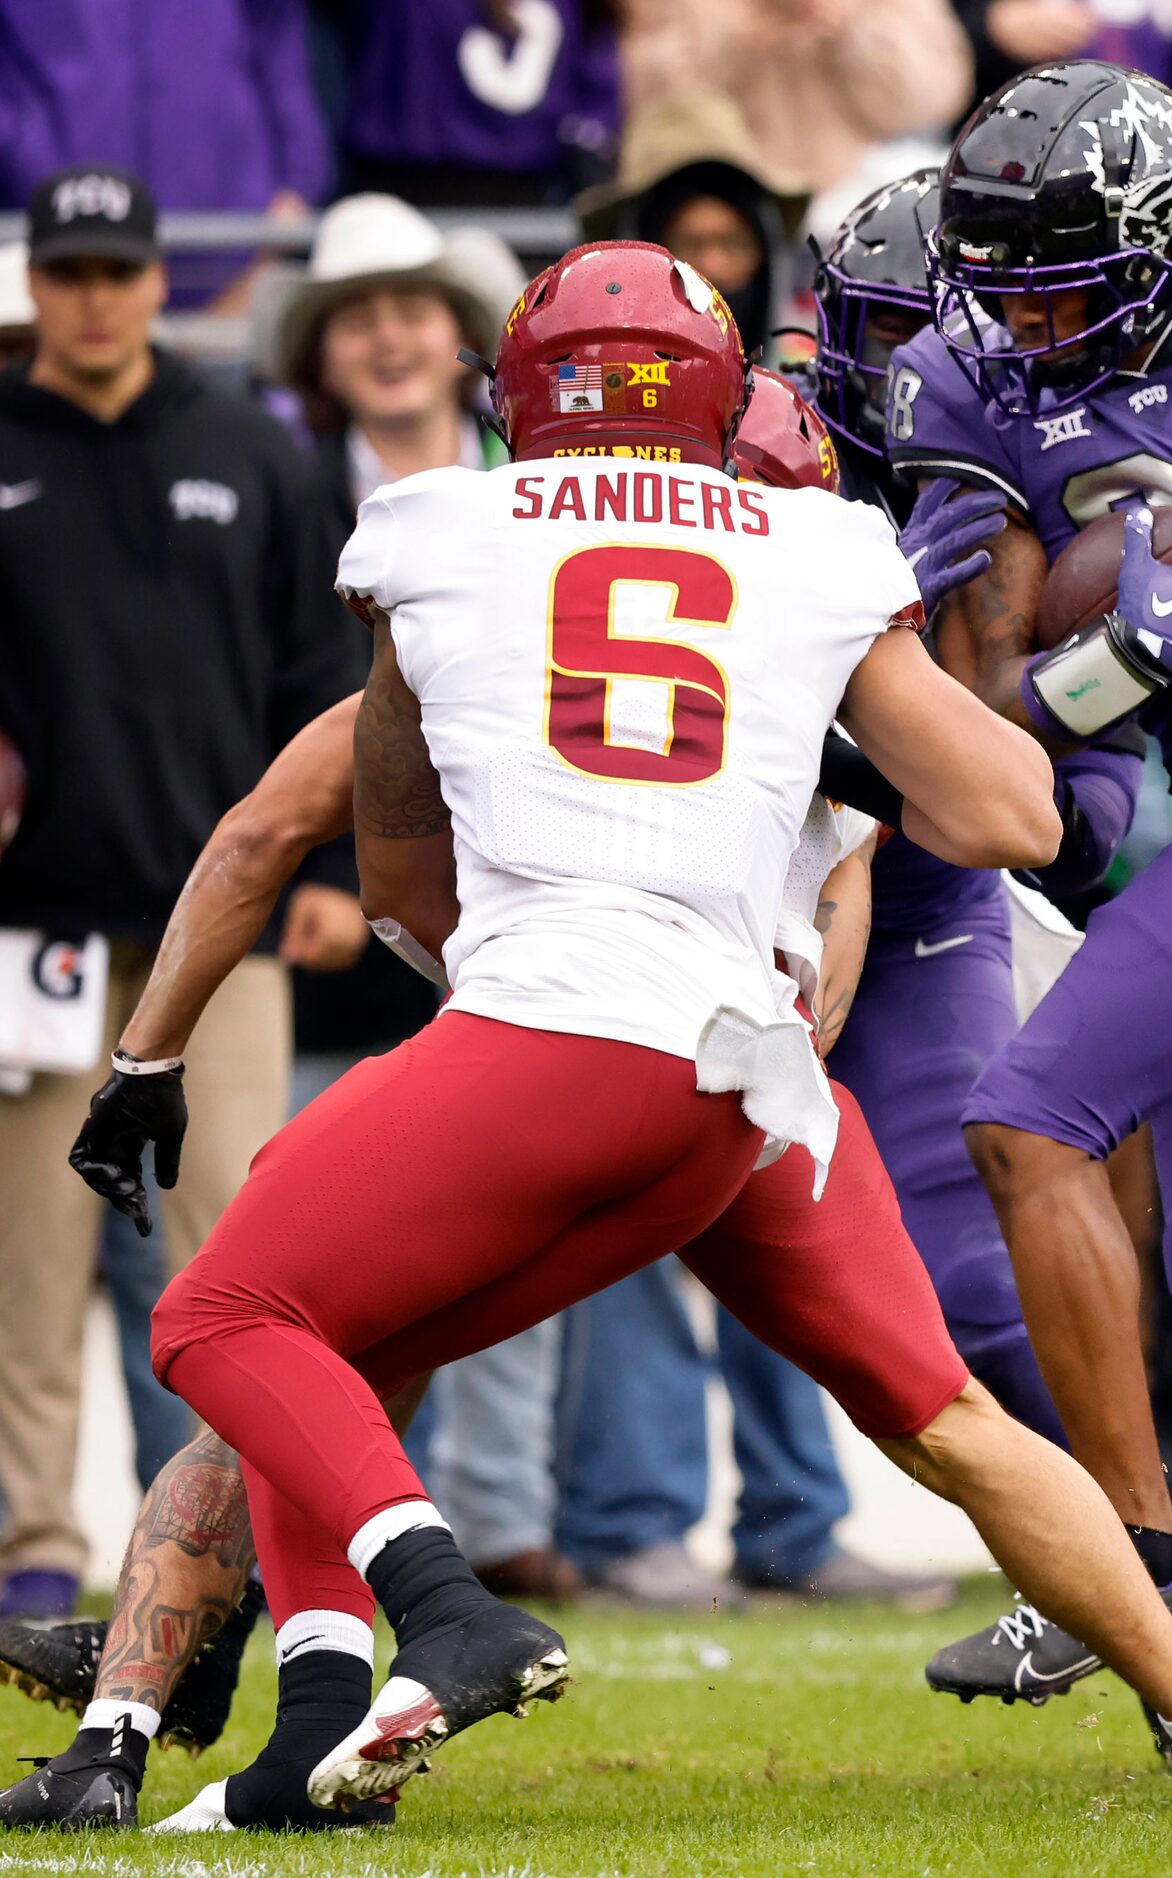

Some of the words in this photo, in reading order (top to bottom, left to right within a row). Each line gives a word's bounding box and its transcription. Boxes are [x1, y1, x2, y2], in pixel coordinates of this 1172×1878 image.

[626, 361, 671, 387] XII
[642, 388, 658, 408] 6
[887, 363, 923, 441] 8
[1128, 384, 1168, 414] TCU
[1034, 407, 1092, 451] XII
[512, 472, 770, 537] SANDERS
[541, 541, 739, 789] 6
